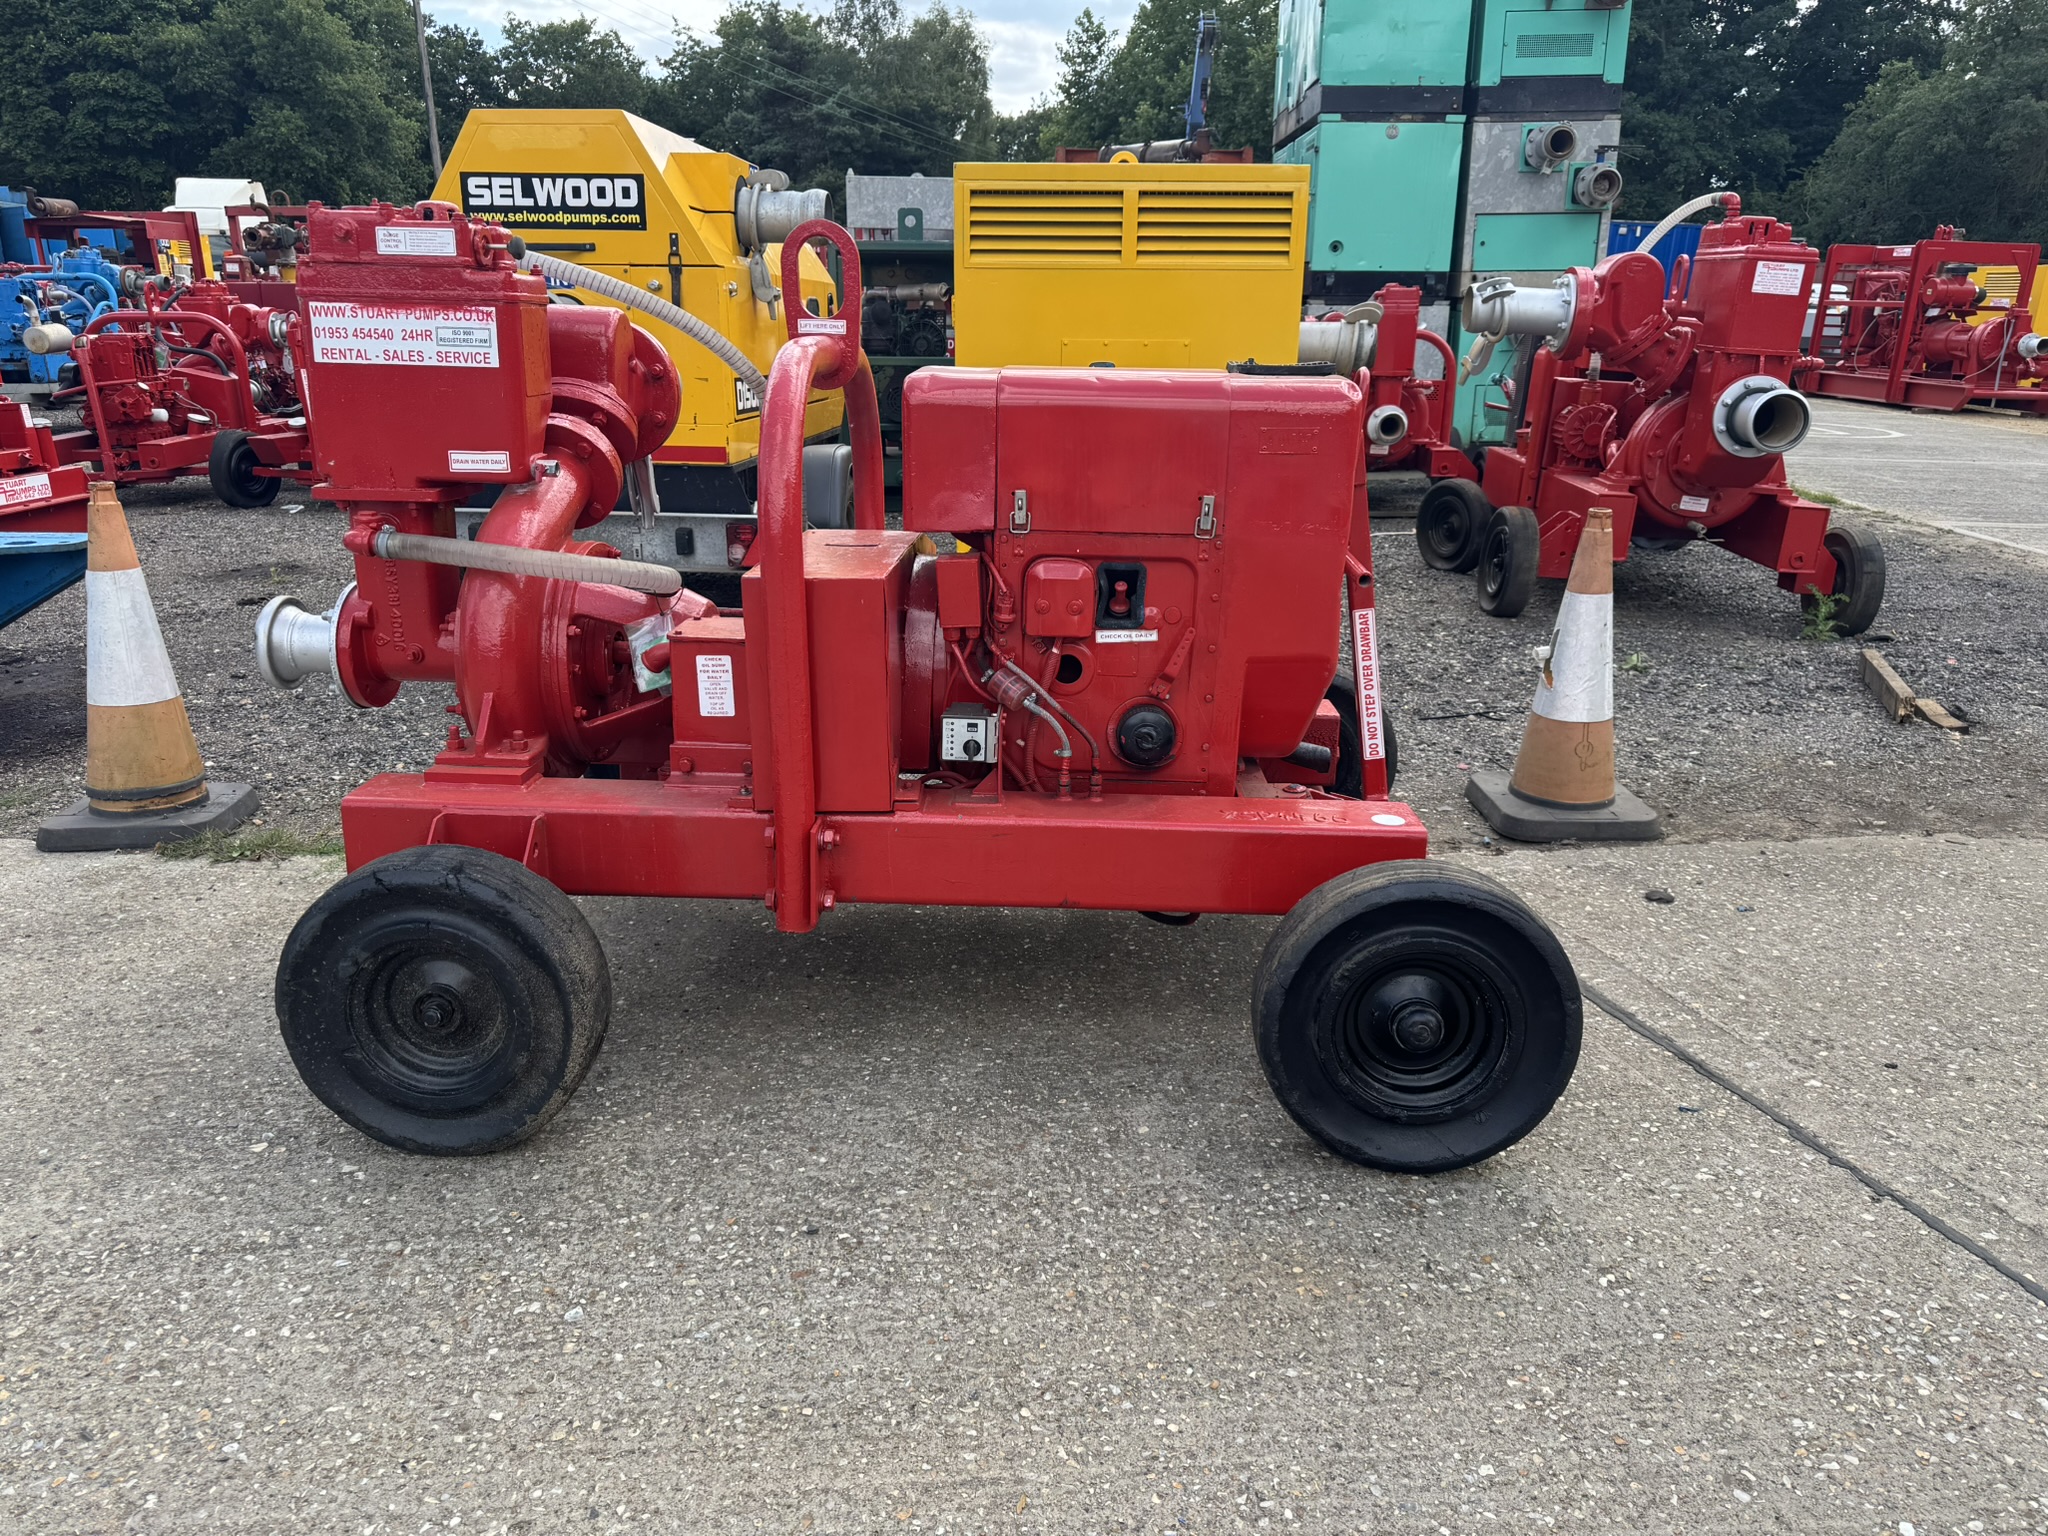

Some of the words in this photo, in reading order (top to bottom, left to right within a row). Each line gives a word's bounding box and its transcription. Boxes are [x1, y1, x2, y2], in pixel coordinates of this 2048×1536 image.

[467, 177, 638, 207] SELWOOD
[313, 326, 349, 339] 01953
[351, 328, 394, 341] 454540
[401, 330, 434, 342] 24HR
[321, 347, 372, 361] RENTAL
[383, 349, 425, 363] SALES
[436, 351, 492, 365] SERVICE
[37, 483, 50, 492] LTD
[1358, 612, 1372, 662] DRAWBAR
[1362, 663, 1374, 691] OVER
[1365, 693, 1377, 718] STEP
[1367, 721, 1378, 741] NOT
[1369, 742, 1380, 757] DO
